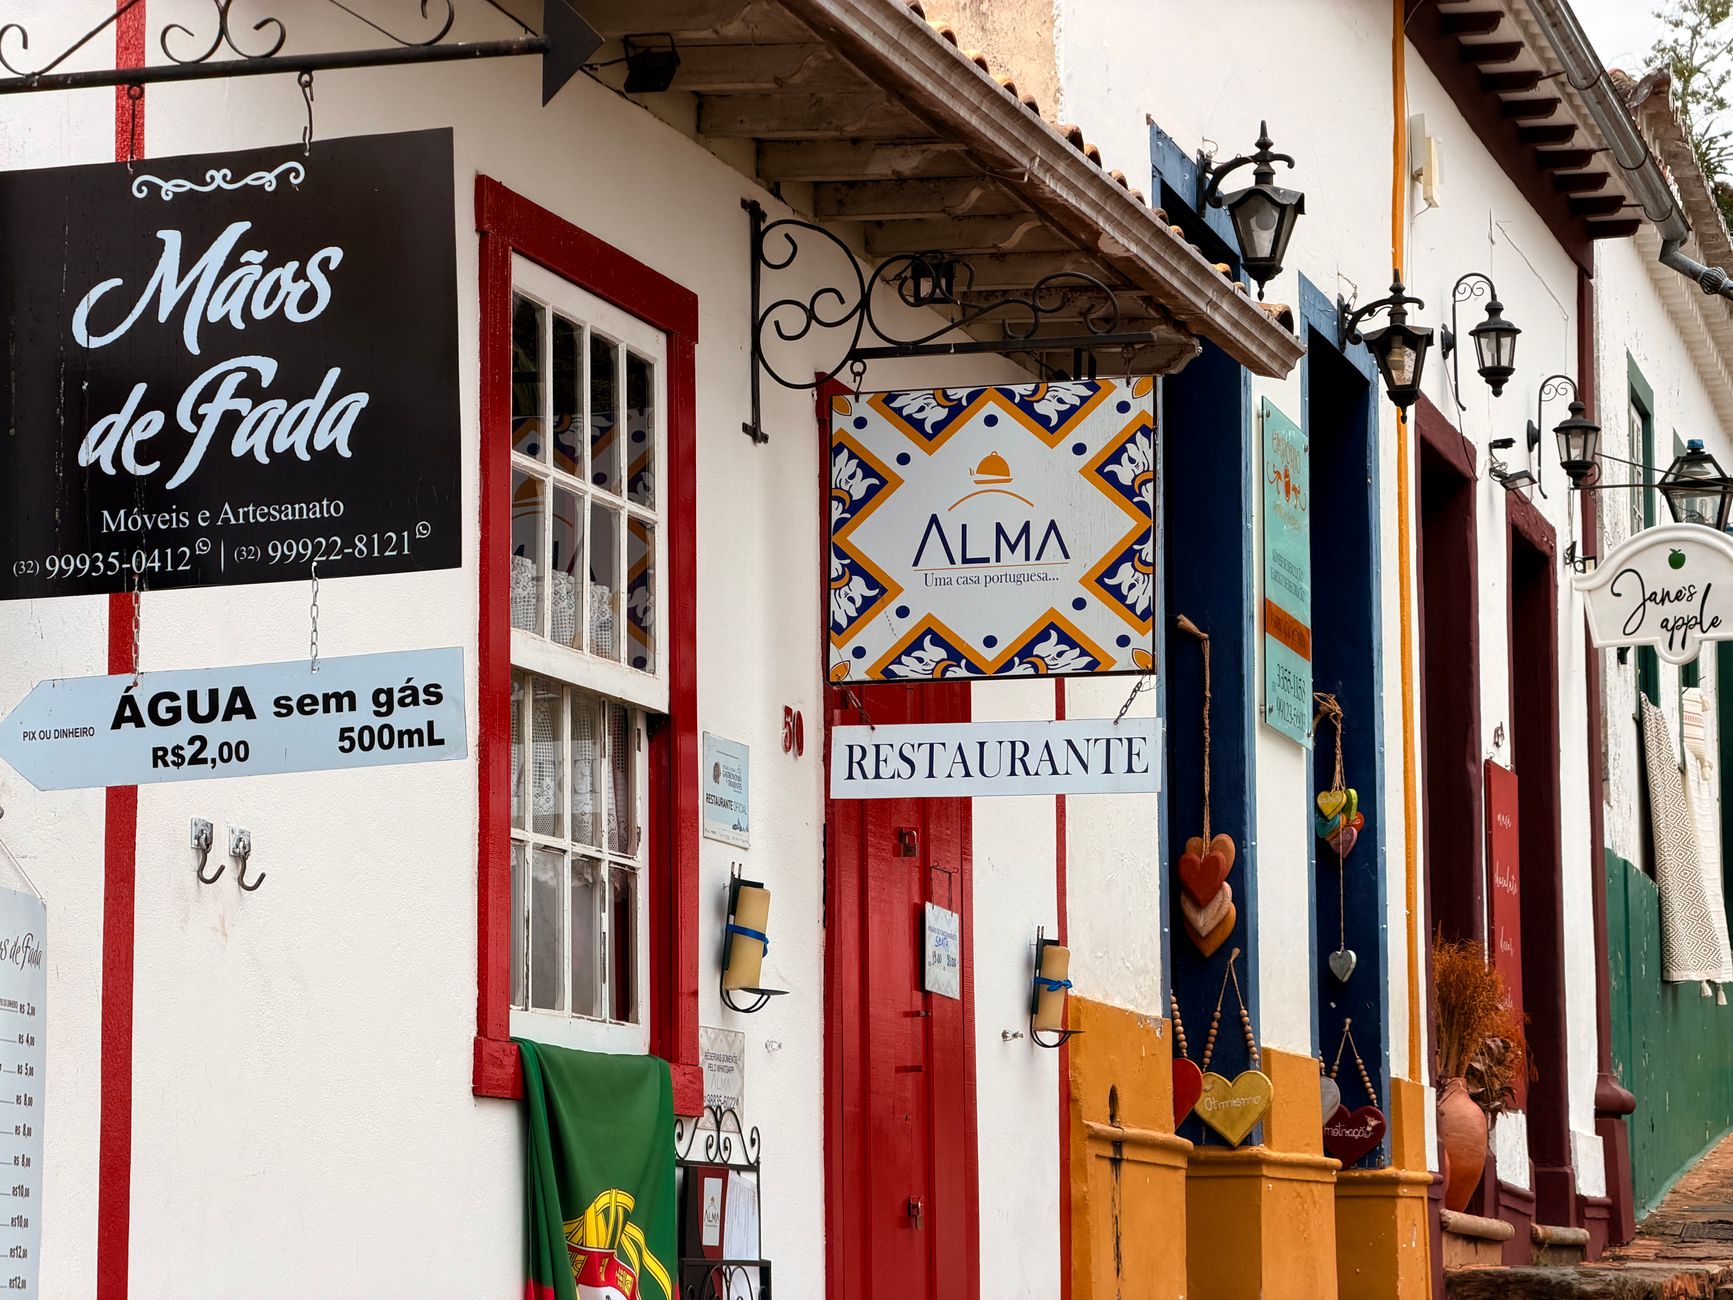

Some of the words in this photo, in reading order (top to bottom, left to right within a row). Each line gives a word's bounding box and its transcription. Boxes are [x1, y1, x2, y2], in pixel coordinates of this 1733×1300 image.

[72, 221, 344, 355] Mãos
[78, 382, 165, 476] de
[166, 355, 369, 490] Fada
[101, 508, 190, 533] Móveis
[198, 510, 210, 527] e
[217, 497, 344, 526] Artesanato
[13, 559, 40, 577] (32)
[46, 546, 191, 579] 99935-0412
[234, 545, 262, 562] (32)
[268, 530, 412, 565] 99922-8121
[912, 514, 1071, 567] ALMA
[924, 572, 953, 588] Uma
[956, 575, 981, 586] casa
[984, 570, 1059, 588] portuguesa...
[1611, 568, 1698, 636] Jane's
[1660, 583, 1723, 651] apple
[110, 686, 257, 730] ÁGUA
[273, 690, 357, 718] sem
[371, 676, 444, 718] gás
[23, 730, 37, 741] PIX
[39, 729, 52, 740] OU
[54, 726, 95, 740] DINHEIRO
[152, 735, 250, 769] R$2,00
[339, 720, 446, 754] 500mL
[784, 705, 804, 757] 50
[843, 736, 1149, 781] RESTAURANTE
[706, 792, 733, 811] RESTAURANTE
